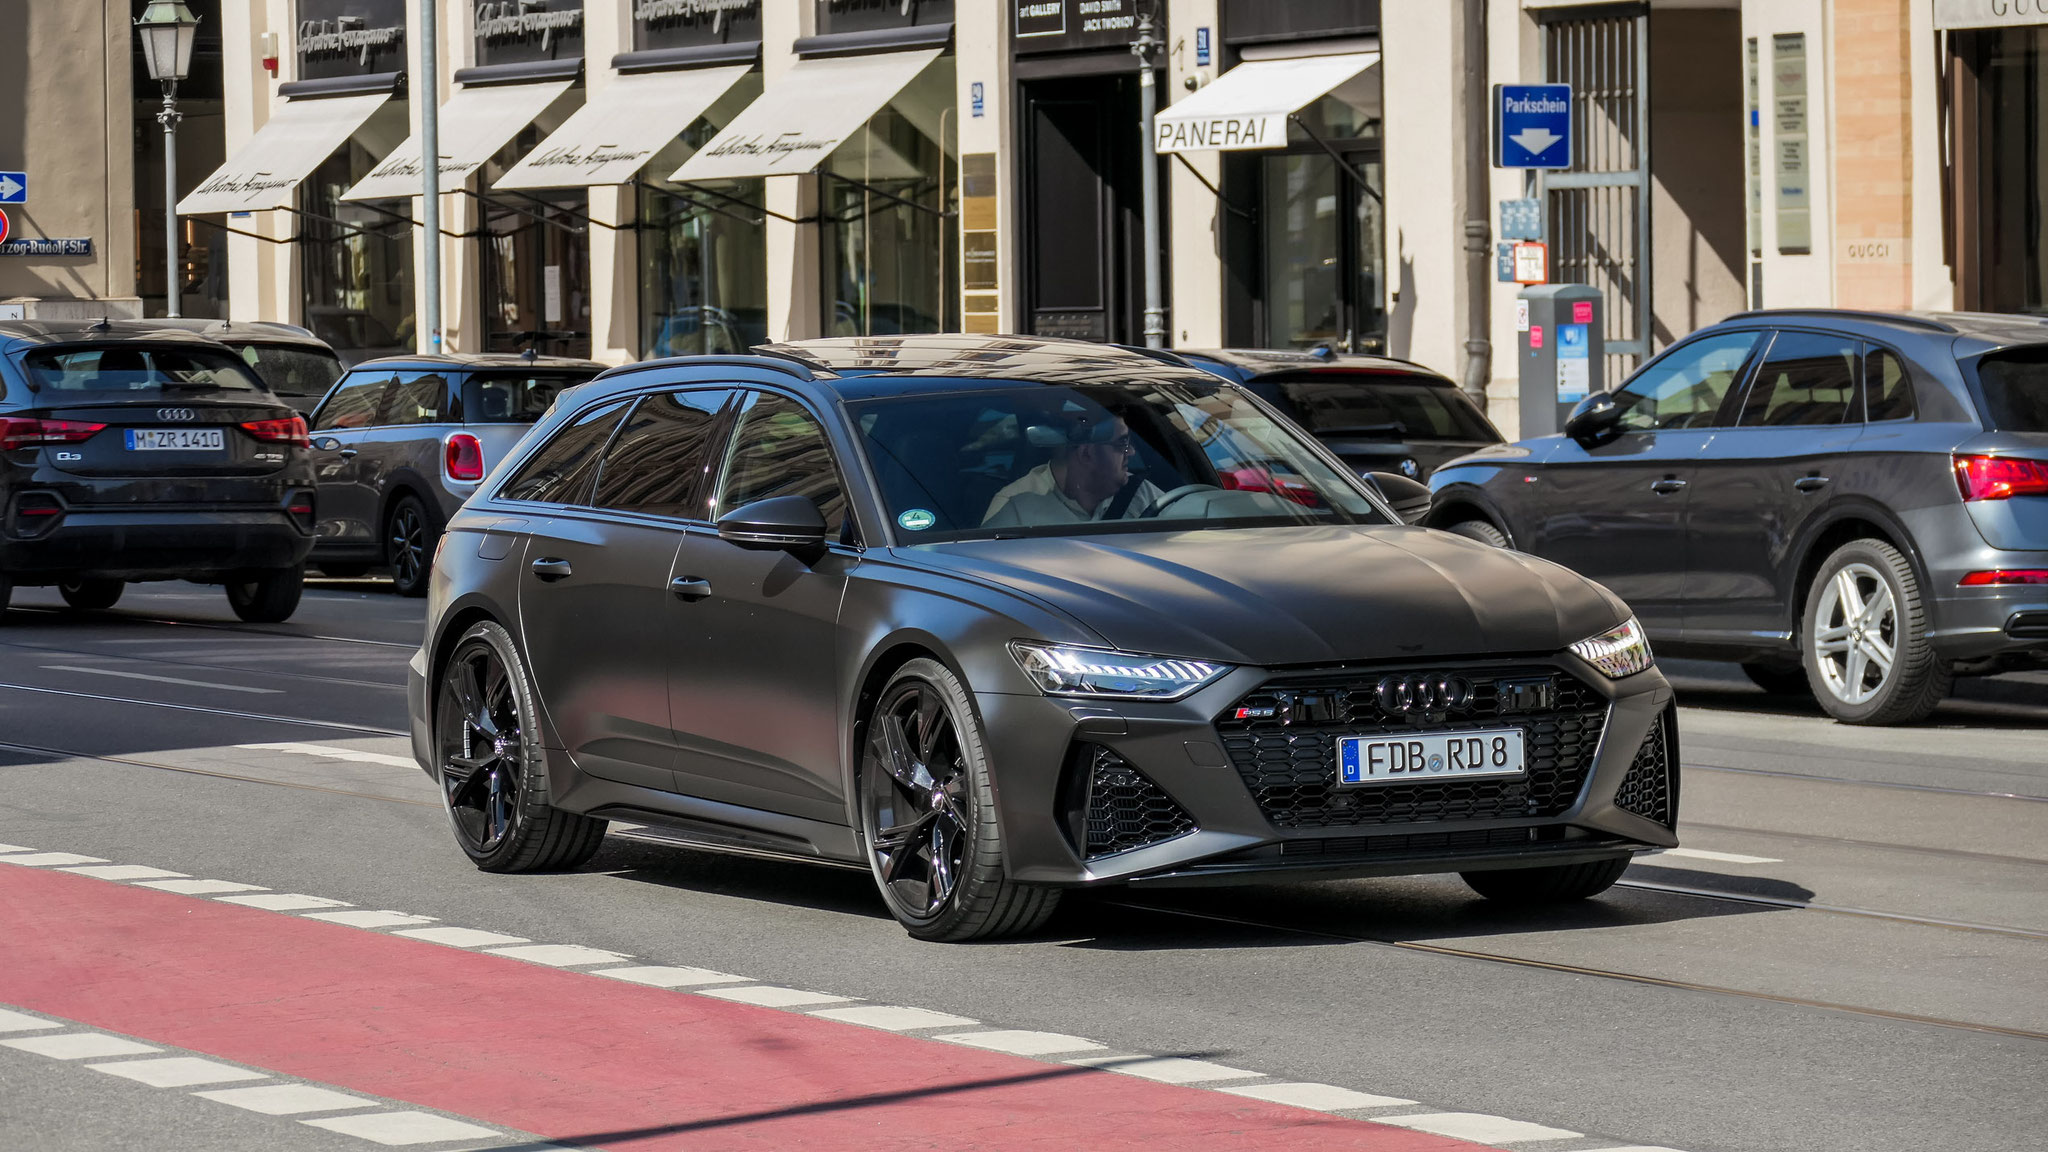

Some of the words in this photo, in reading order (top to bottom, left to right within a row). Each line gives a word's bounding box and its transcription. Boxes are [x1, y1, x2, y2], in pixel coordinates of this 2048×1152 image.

[1029, 2, 1061, 17] GALLERY
[1079, 1, 1101, 14] DAVID
[1083, 18, 1101, 32] JACK
[1505, 96, 1567, 114] Parkschein
[1158, 118, 1266, 148] PANERAI
[0, 240, 88, 256] rzog-Rudolf-Str.
[1848, 243, 1889, 258] GUCCI
[136, 432, 146, 448] M
[157, 432, 178, 448] ZR
[181, 432, 220, 448] 1410
[1367, 741, 1426, 775] FDB
[1446, 737, 1484, 771] RD
[1491, 736, 1508, 767] 8
[1347, 765, 1355, 775] D
